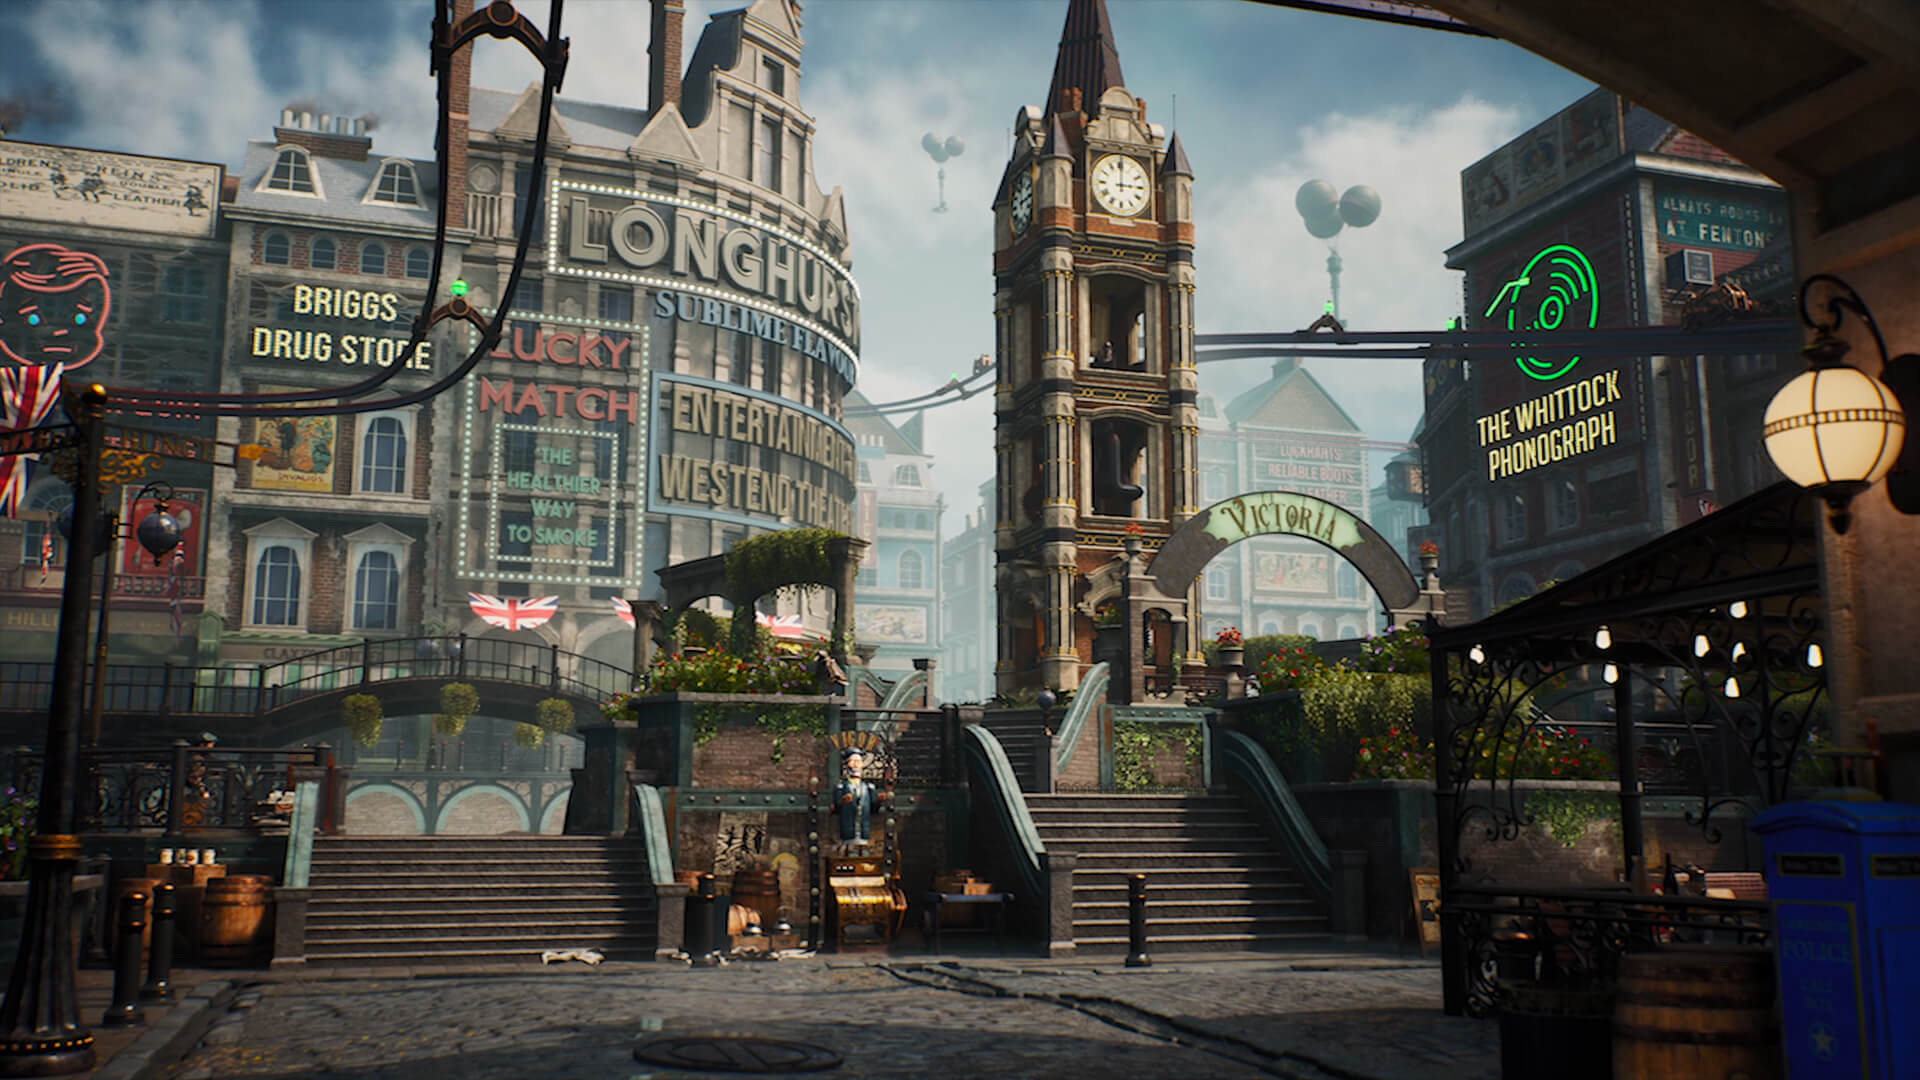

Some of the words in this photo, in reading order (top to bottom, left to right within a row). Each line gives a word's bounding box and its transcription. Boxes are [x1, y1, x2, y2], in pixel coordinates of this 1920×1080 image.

[1662, 196, 1713, 215] ALWAYS
[1666, 219, 1687, 237] AT
[293, 285, 398, 322] BRIGGS
[655, 289, 787, 346] SUBLIME
[252, 327, 332, 362] DRUG
[479, 376, 637, 425] MATCH
[1476, 408, 1512, 447] THE
[1514, 369, 1621, 433] WHITTOCK
[540, 446, 572, 466] THE
[1488, 410, 1617, 481] PHONOGRAPH
[507, 471, 601, 494] HEALTHIER
[660, 453, 792, 517] WESTEND
[1268, 463, 1318, 480] RELIABLE
[1320, 466, 1354, 484] BOOTS
[530, 499, 576, 519] WAY
[1220, 497, 1337, 544] VICTORIA
[507, 524, 532, 543] TO
[534, 527, 599, 547] SMOKE
[829, 730, 880, 751] VIGOR
